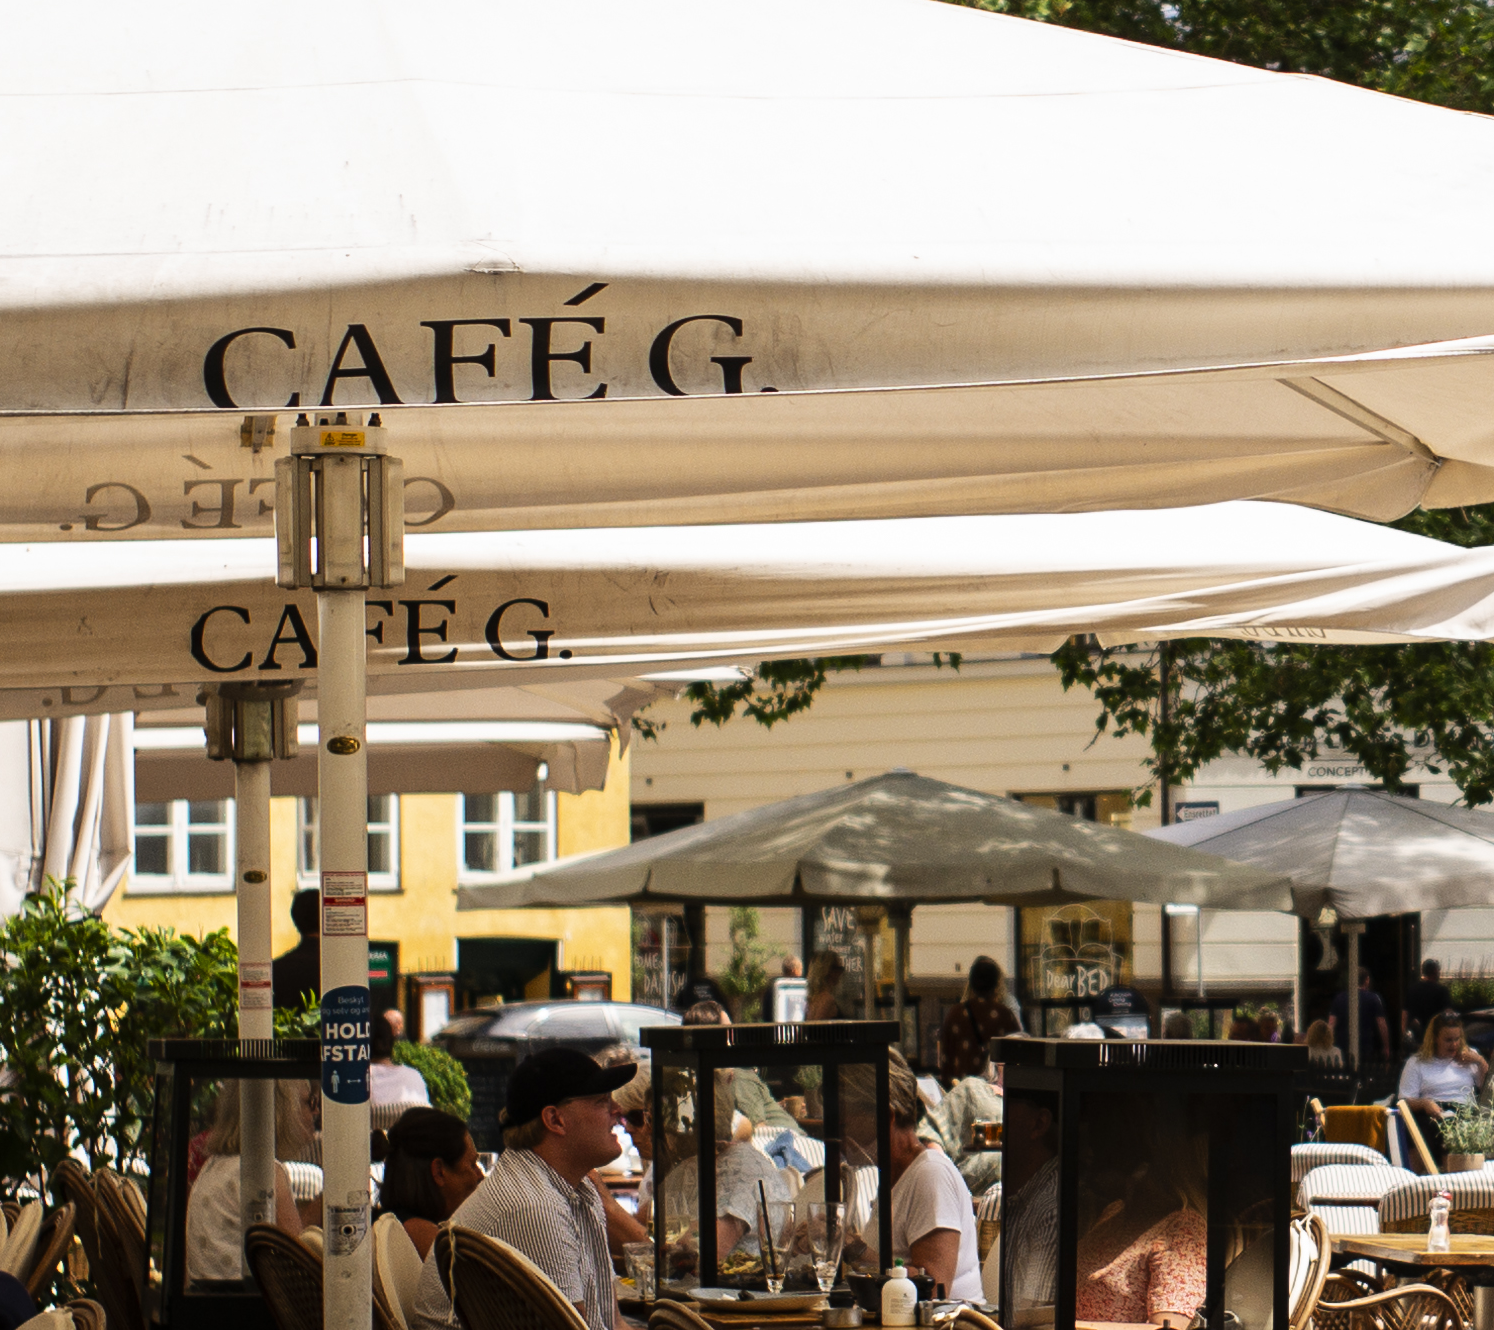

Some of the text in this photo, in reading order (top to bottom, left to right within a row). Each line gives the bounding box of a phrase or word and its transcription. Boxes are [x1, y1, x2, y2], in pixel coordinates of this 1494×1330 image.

[203, 282, 609, 409] CAFÉ
[484, 597, 574, 662] G.
[1046, 965, 1109, 998] Dear BED
[321, 1044, 371, 1062] FSTA
